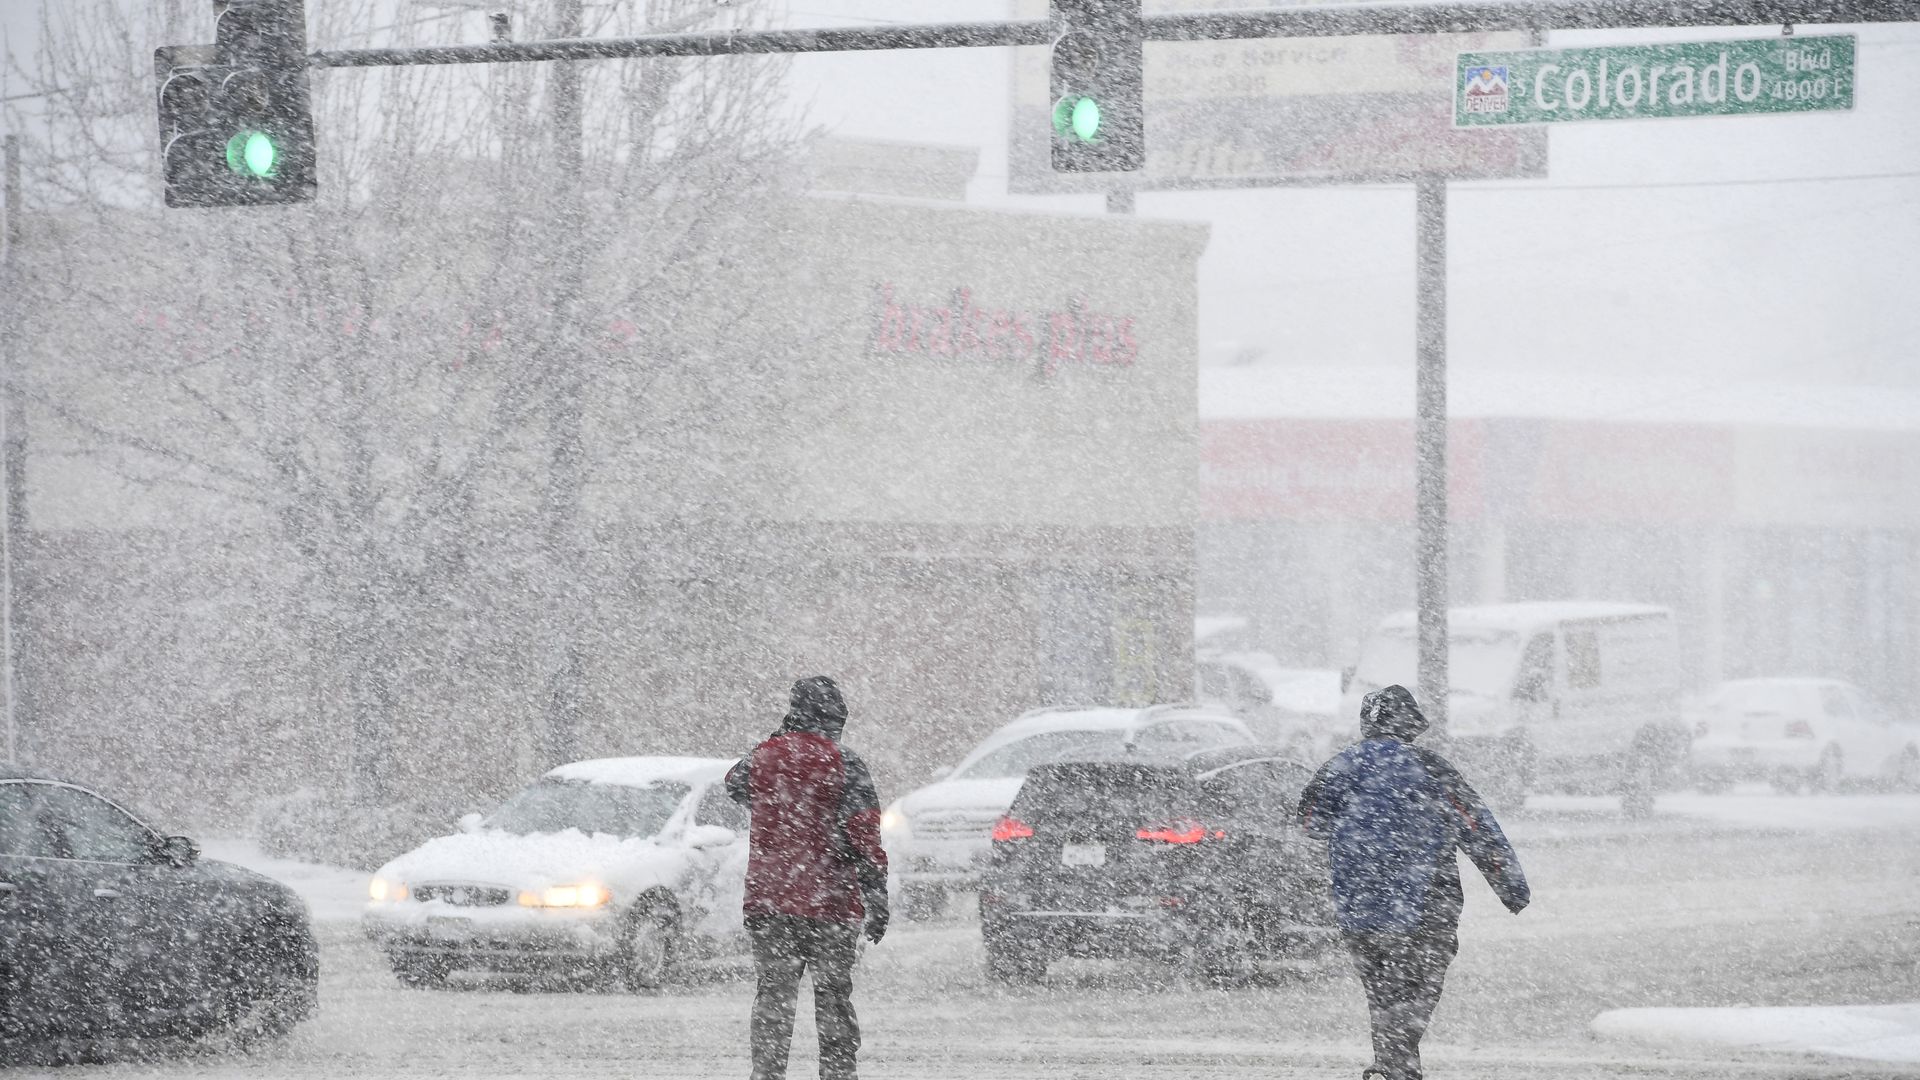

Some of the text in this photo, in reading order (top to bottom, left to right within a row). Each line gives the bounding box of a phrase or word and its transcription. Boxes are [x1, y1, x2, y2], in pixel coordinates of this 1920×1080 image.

[1785, 48, 1831, 72] Blvd
[1514, 53, 1762, 111] S Colorado
[1771, 78, 1844, 100] 4000 E
[1465, 96, 1507, 112] DENVER
[874, 281, 1139, 378] brakes plus
